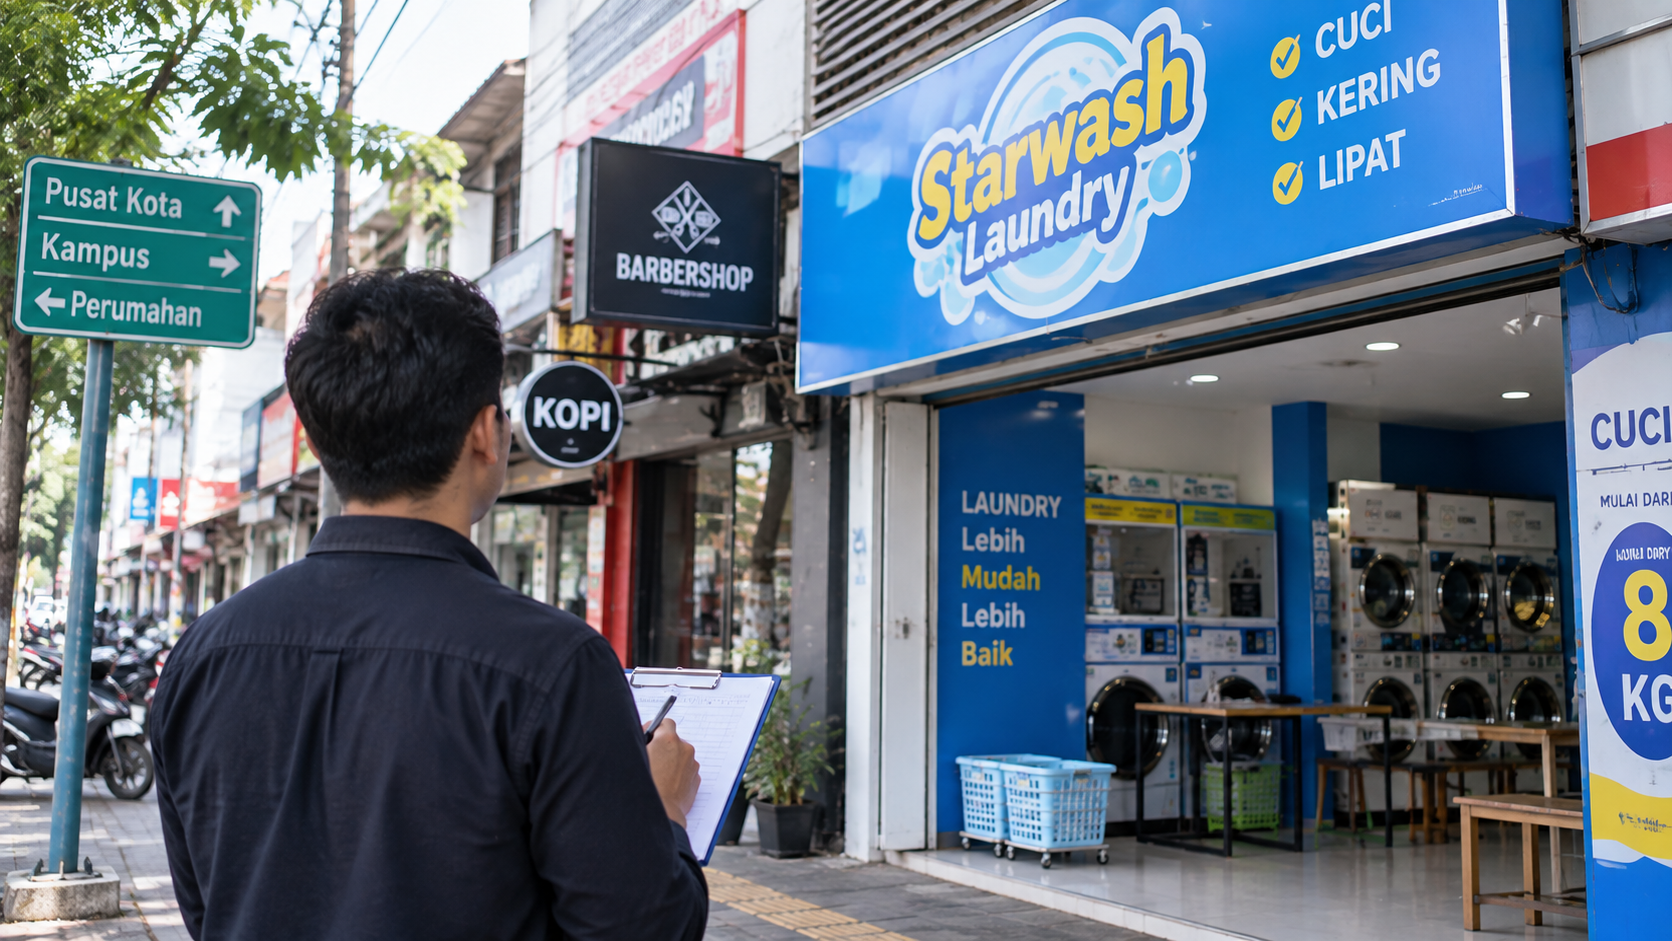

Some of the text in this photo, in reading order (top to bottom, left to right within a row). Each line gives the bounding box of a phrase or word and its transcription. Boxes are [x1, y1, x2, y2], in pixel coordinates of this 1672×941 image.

[1315, 0, 1392, 58] CUCI
[1316, 48, 1441, 125] KERING
[918, 33, 1188, 241] Starwash
[1318, 128, 1406, 190] LIPAT
[45, 177, 183, 219] Pusat Kota
[964, 166, 1130, 276] Laundry
[41, 232, 150, 272] Kampus
[616, 252, 754, 292] BARBERSHOP
[71, 290, 202, 328] Perumahan
[533, 396, 611, 432] KOPI
[1590, 405, 1672, 451] CUCI
[962, 490, 1062, 519] LAUNDRY
[1600, 493, 1638, 508] MULAI
[962, 526, 1025, 553] Lebih
[962, 564, 1041, 591] Mudah
[962, 602, 1025, 628] Lebih
[1623, 569, 1672, 662] 8
[962, 639, 1014, 666] Baik
[1622, 673, 1672, 724] KG
